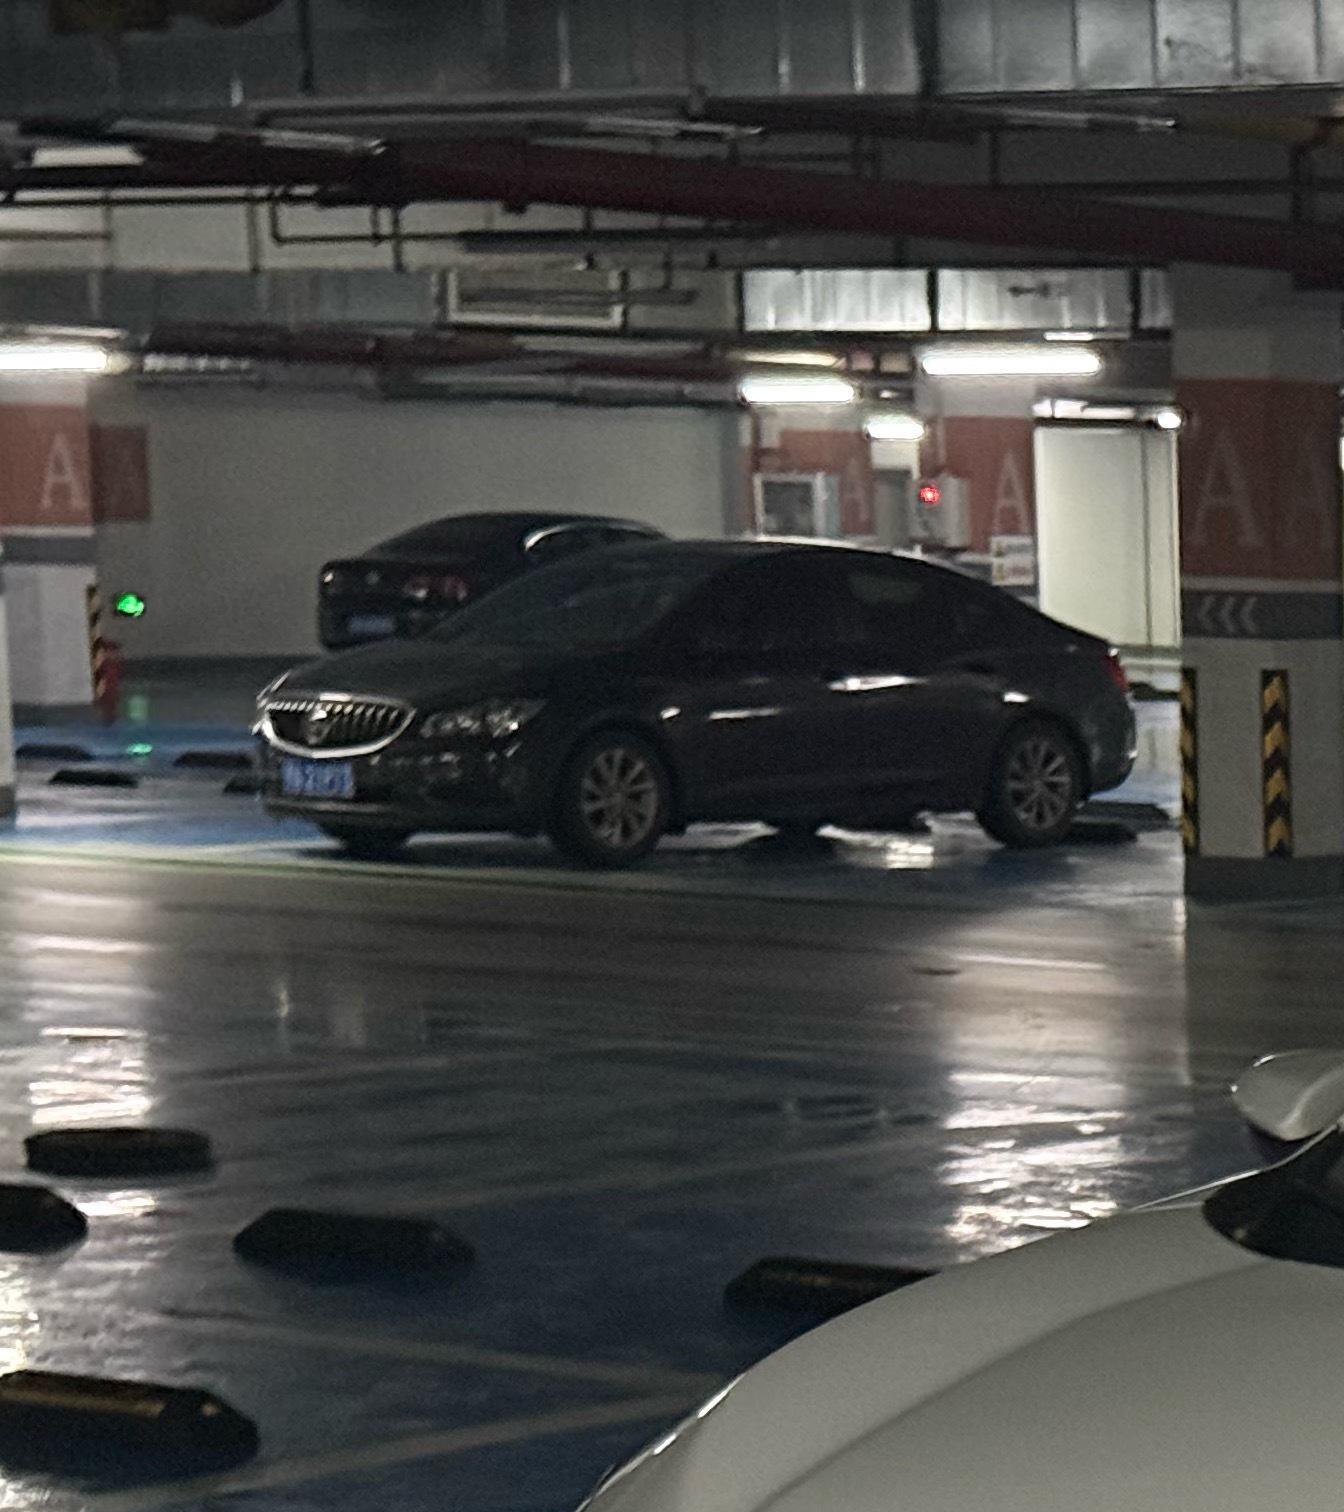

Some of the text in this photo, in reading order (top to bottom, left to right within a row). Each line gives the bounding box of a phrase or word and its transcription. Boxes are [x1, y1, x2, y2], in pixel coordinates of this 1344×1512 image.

[41, 432, 85, 509] A
[994, 451, 1030, 533] A
[1185, 426, 1264, 550] A
